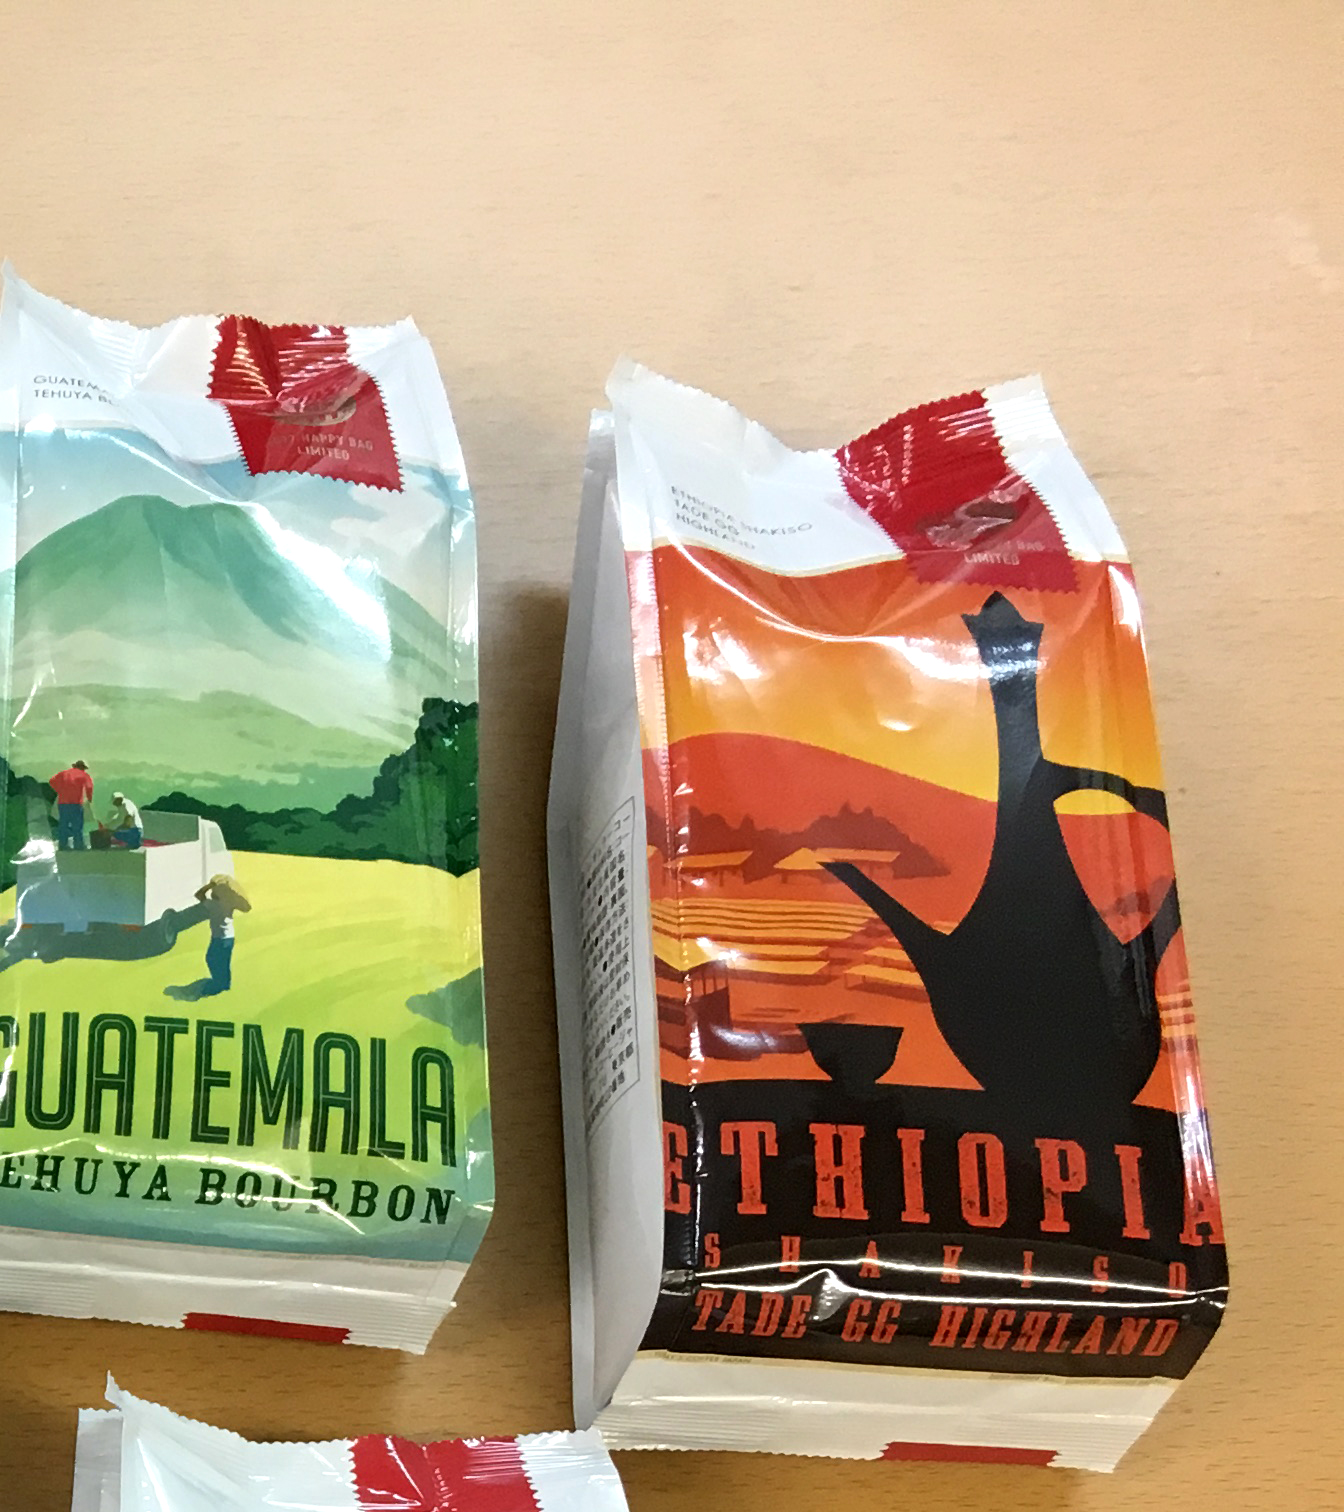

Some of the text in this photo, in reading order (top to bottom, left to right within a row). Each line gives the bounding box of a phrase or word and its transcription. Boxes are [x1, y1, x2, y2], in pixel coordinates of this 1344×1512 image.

[33, 389, 93, 401] TEHUYA
[297, 445, 350, 460] LIMITED
[302, 434, 344, 447] HAPPY
[348, 436, 374, 451] BAG
[964, 552, 1019, 566] LIMITED
[194, 1167, 456, 1226] BOURBON
[662, 1119, 1224, 1245] ETHIOPIA
[703, 1233, 1188, 1300] SHAKISO
[692, 1290, 1180, 1357] TADE GG HIGHLAND
